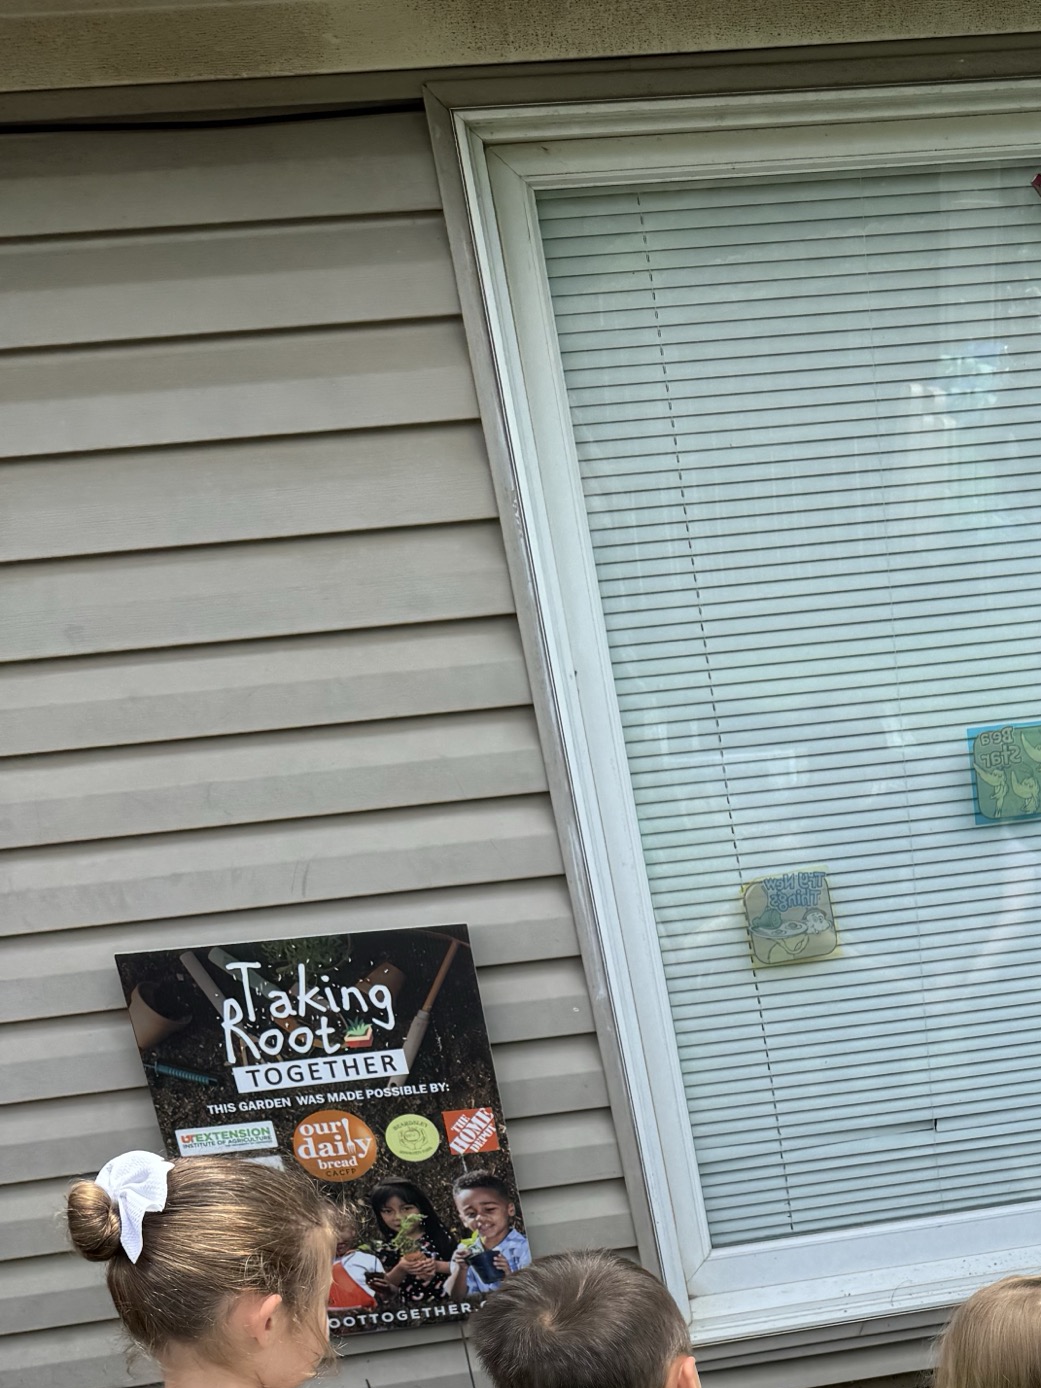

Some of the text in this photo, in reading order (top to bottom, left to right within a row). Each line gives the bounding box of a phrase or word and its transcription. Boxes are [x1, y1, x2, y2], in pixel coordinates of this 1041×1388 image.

[226, 962, 395, 1030] Taking
[221, 998, 341, 1064] Root
[245, 1055, 398, 1088] TOGETHER
[206, 1082, 450, 1115] THIS GARDEN WAS MADE POSSIBLE BY:
[298, 1121, 342, 1137] our
[449, 1107, 494, 1154] HOME
[451, 1114, 471, 1133] THE
[469, 1123, 497, 1153] DEPOT
[183, 1141, 216, 1149] INSTITUTE
[228, 1135, 273, 1144] AGRICULTURE
[317, 1156, 359, 1170] bread
[325, 1168, 357, 1177] CACFP
